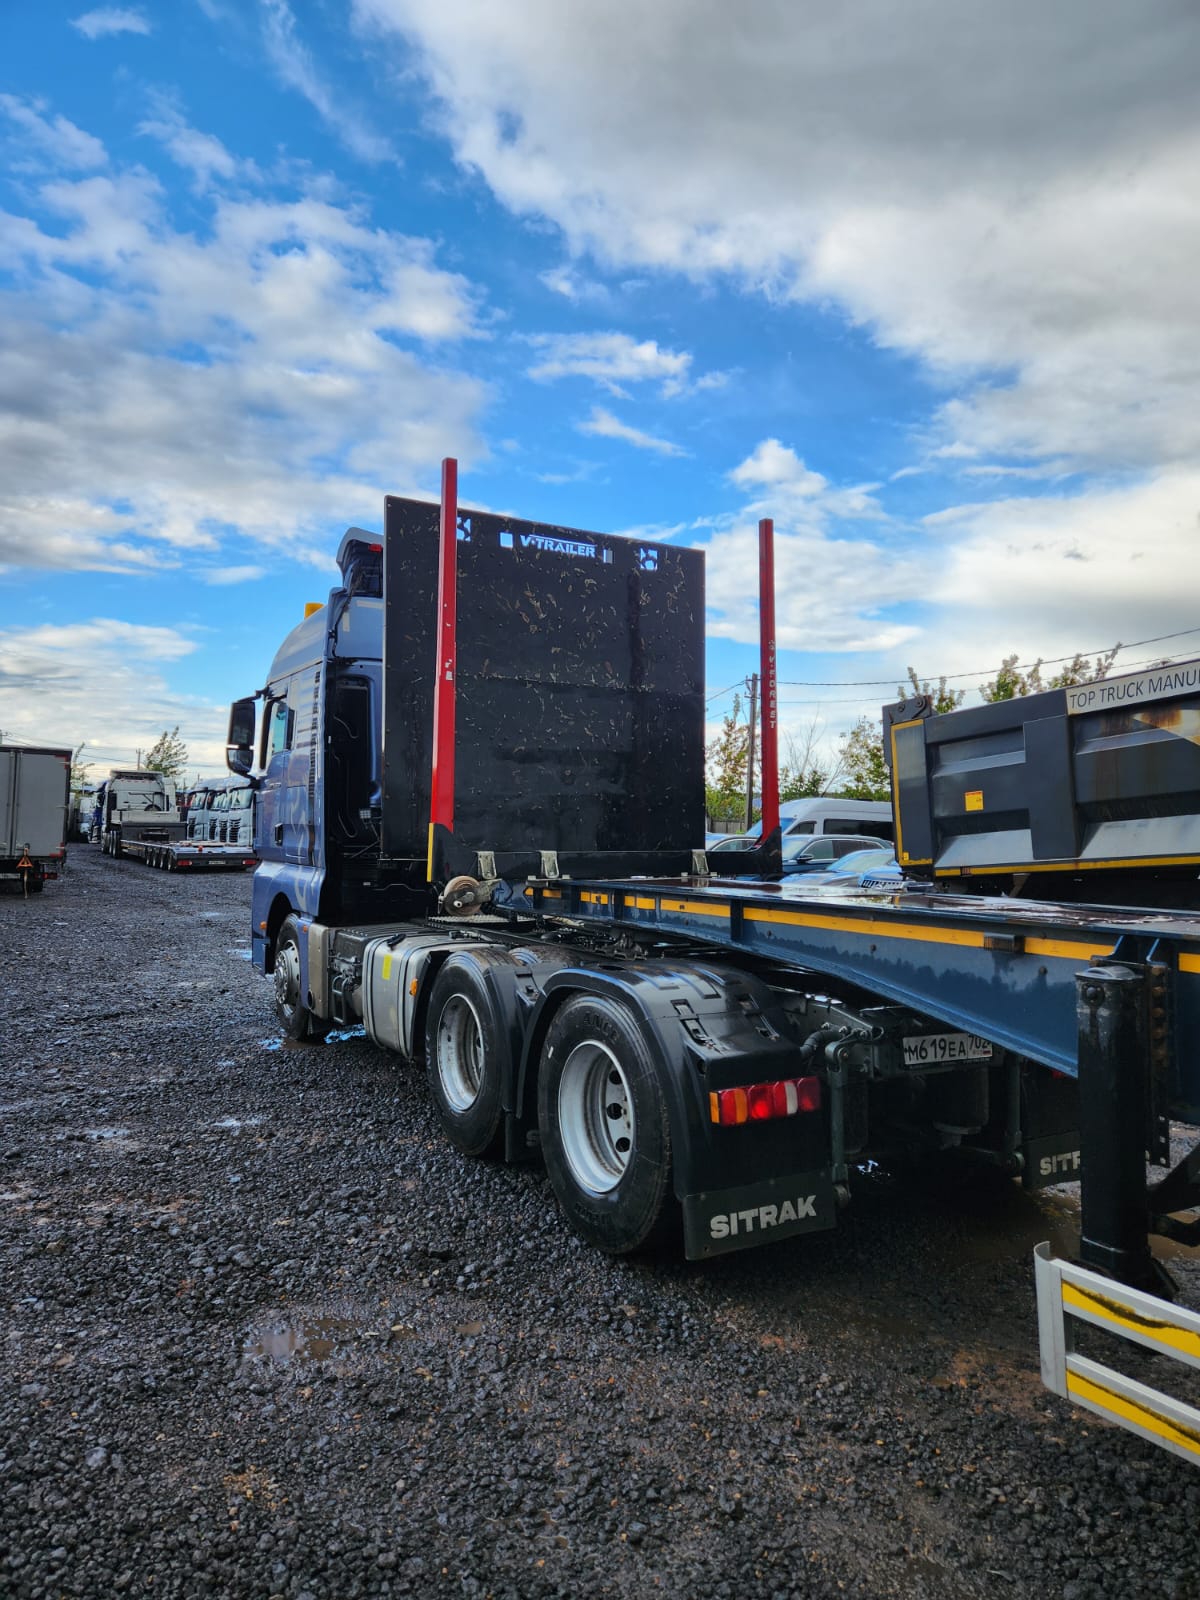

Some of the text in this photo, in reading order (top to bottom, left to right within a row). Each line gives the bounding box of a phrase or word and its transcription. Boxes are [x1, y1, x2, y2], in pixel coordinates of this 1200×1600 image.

[1070, 668, 1200, 709] TOP TRUCK MANU
[710, 1195, 817, 1239] SITRAK
